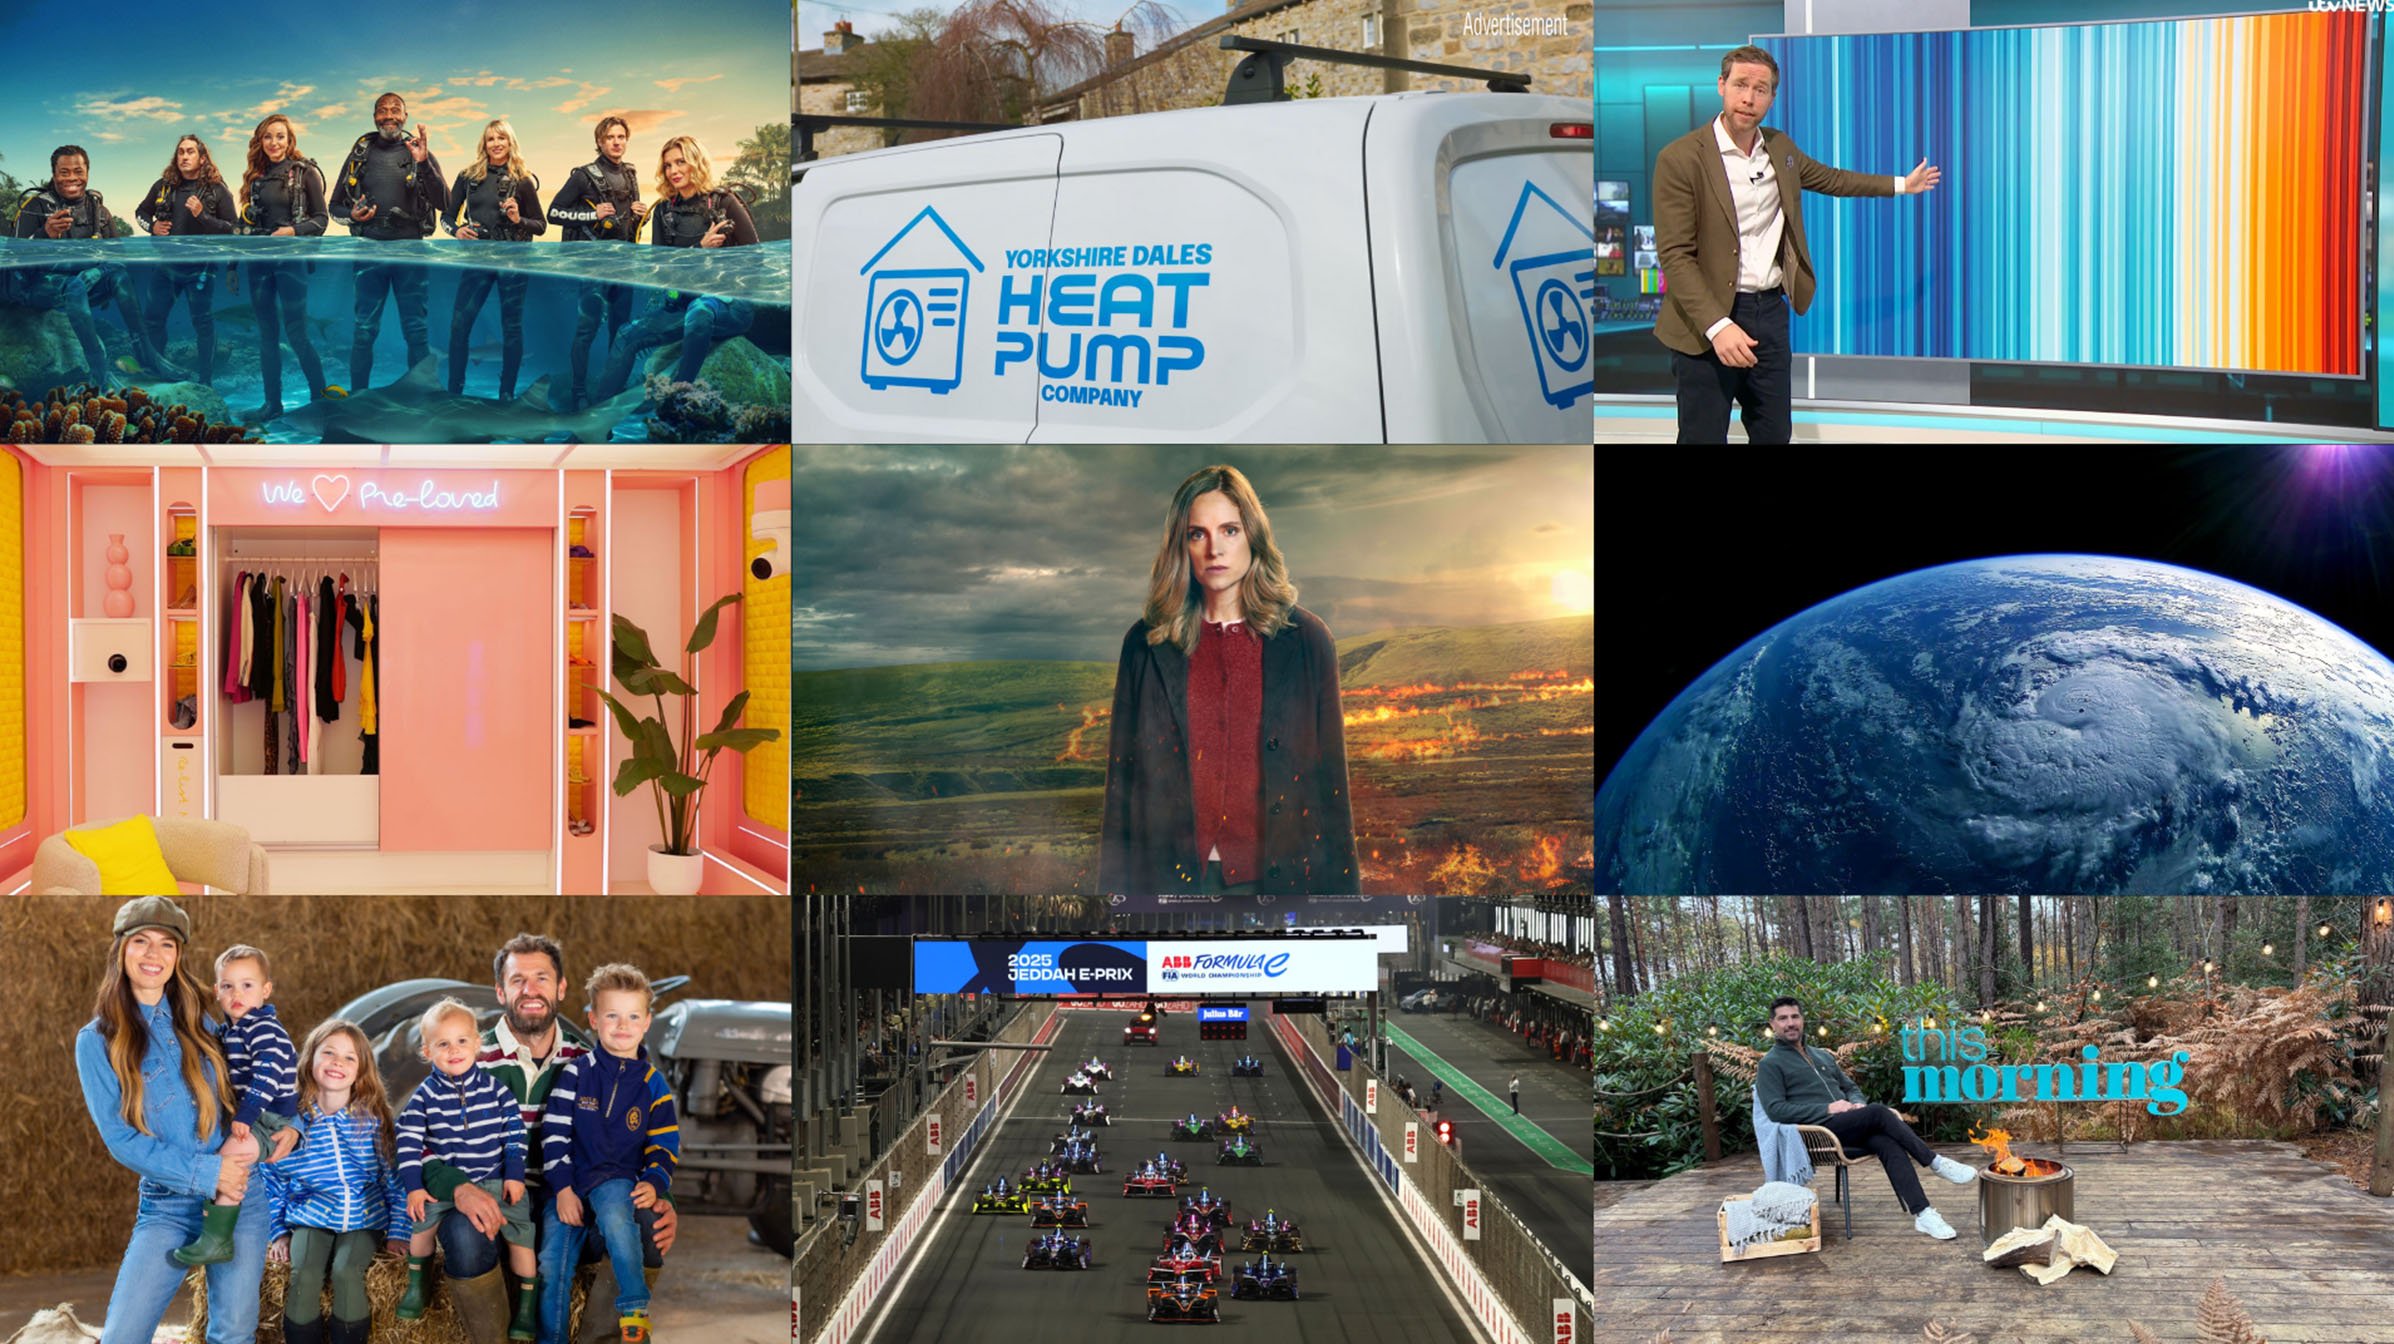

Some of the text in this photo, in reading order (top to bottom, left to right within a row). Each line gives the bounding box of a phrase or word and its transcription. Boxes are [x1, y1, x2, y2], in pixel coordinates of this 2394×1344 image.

[550, 208, 598, 221] DOUGIE
[1006, 244, 1212, 269] YORKSHIRE DALES
[998, 273, 1210, 328] HEAT
[994, 331, 1205, 385] PUMP
[1041, 384, 1143, 408] COMPANY
[262, 479, 499, 510] We Pre-loved
[1007, 954, 1052, 967] 2025
[1162, 956, 1192, 968] ABB
[1193, 953, 1266, 970] FORMULA
[1007, 968, 1133, 981] JEDDAH E-PRIX
[1161, 971, 1179, 980] FIA
[1203, 1009, 1226, 1020] Julius
[1899, 1017, 1987, 1062] this
[1900, 1045, 2190, 1116] morning
[1368, 1086, 1376, 1107] ABB
[930, 1122, 940, 1146] ABB
[1406, 1130, 1416, 1154] ABB
[870, 1190, 881, 1220] ABB
[1466, 1200, 1478, 1229] ABB
[1556, 1312, 1572, 1344] ABB
